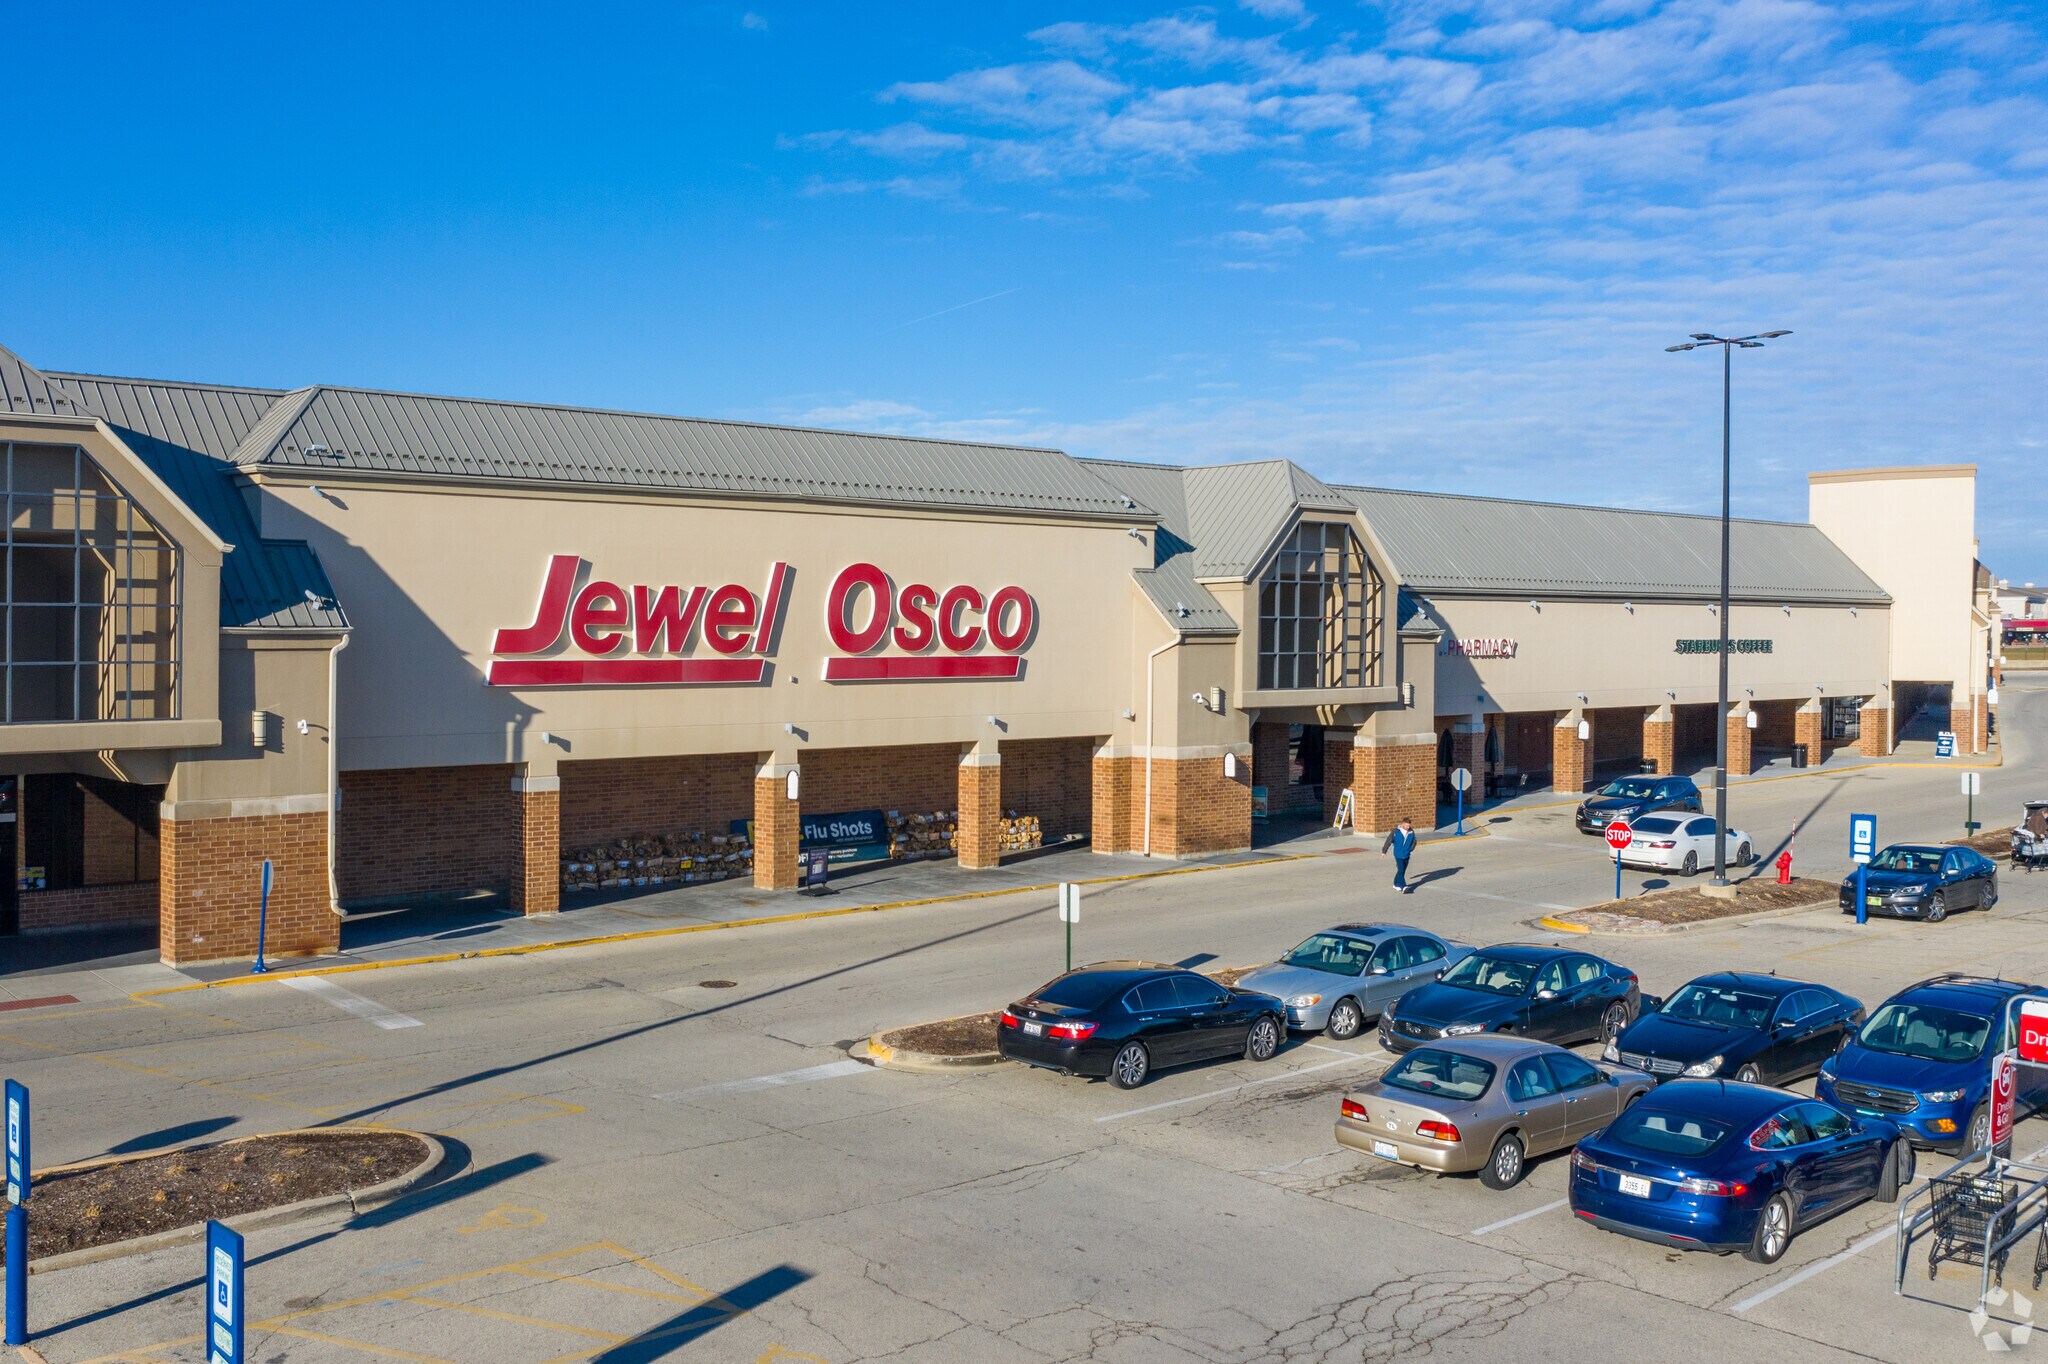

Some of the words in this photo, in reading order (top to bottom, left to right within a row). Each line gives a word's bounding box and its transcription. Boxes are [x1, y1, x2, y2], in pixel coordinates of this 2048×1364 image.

[490, 554, 788, 655] Jewel
[824, 562, 1034, 655] Osco
[1447, 638, 1517, 657] PHARMACY
[1676, 639, 1737, 654] STARBUS
[1737, 639, 1774, 654] COFFEE
[804, 824, 828, 840] Flu
[830, 820, 873, 838] Shots
[1607, 829, 1631, 842] STOP
